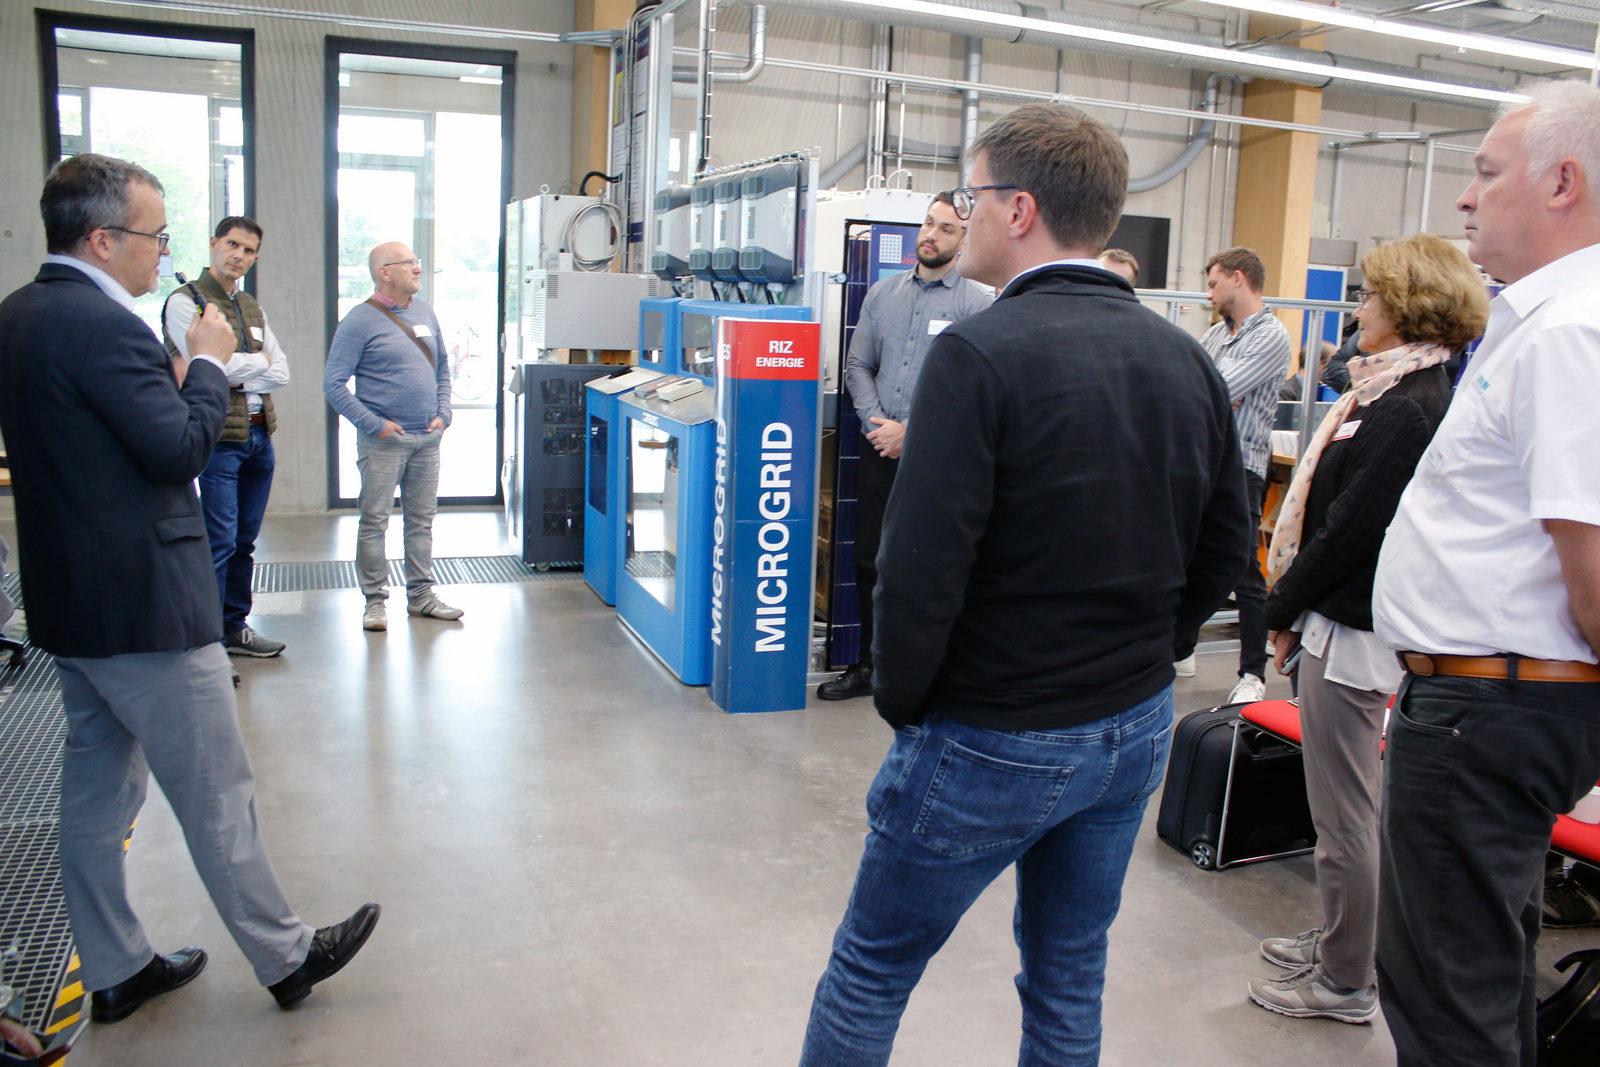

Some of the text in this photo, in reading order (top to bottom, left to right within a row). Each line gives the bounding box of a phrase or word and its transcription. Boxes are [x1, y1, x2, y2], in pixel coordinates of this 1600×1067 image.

[755, 356, 805, 368] ENERGIE
[768, 340, 794, 354] RIZ
[710, 417, 727, 647] MICROGRID
[755, 421, 793, 653] MICROGRID
